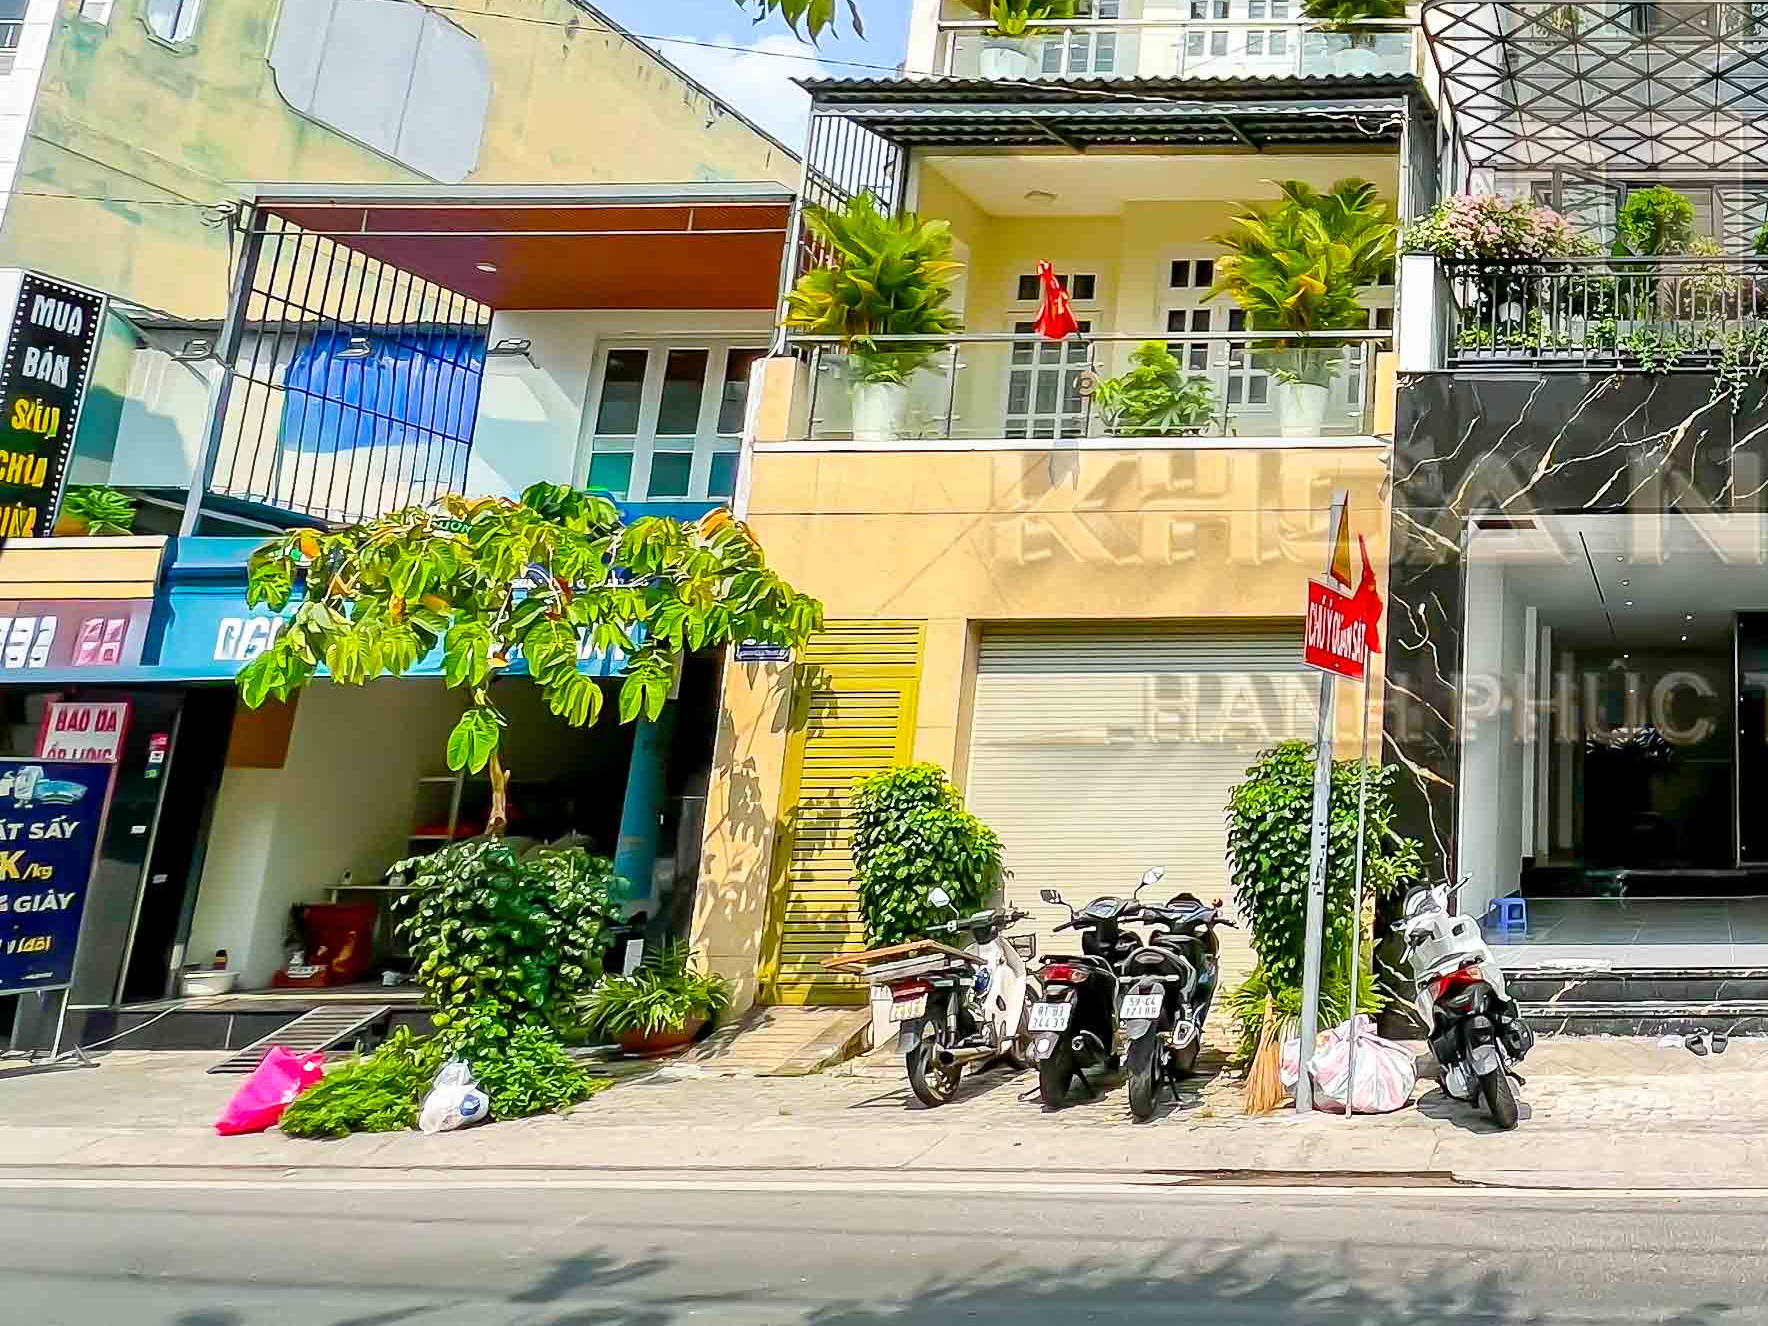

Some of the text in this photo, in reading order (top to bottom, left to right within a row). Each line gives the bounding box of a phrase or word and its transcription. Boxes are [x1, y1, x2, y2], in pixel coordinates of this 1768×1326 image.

[30, 294, 84, 337] MUA
[22, 345, 71, 390] BÁN
[28, 815, 81, 840] SẤY
